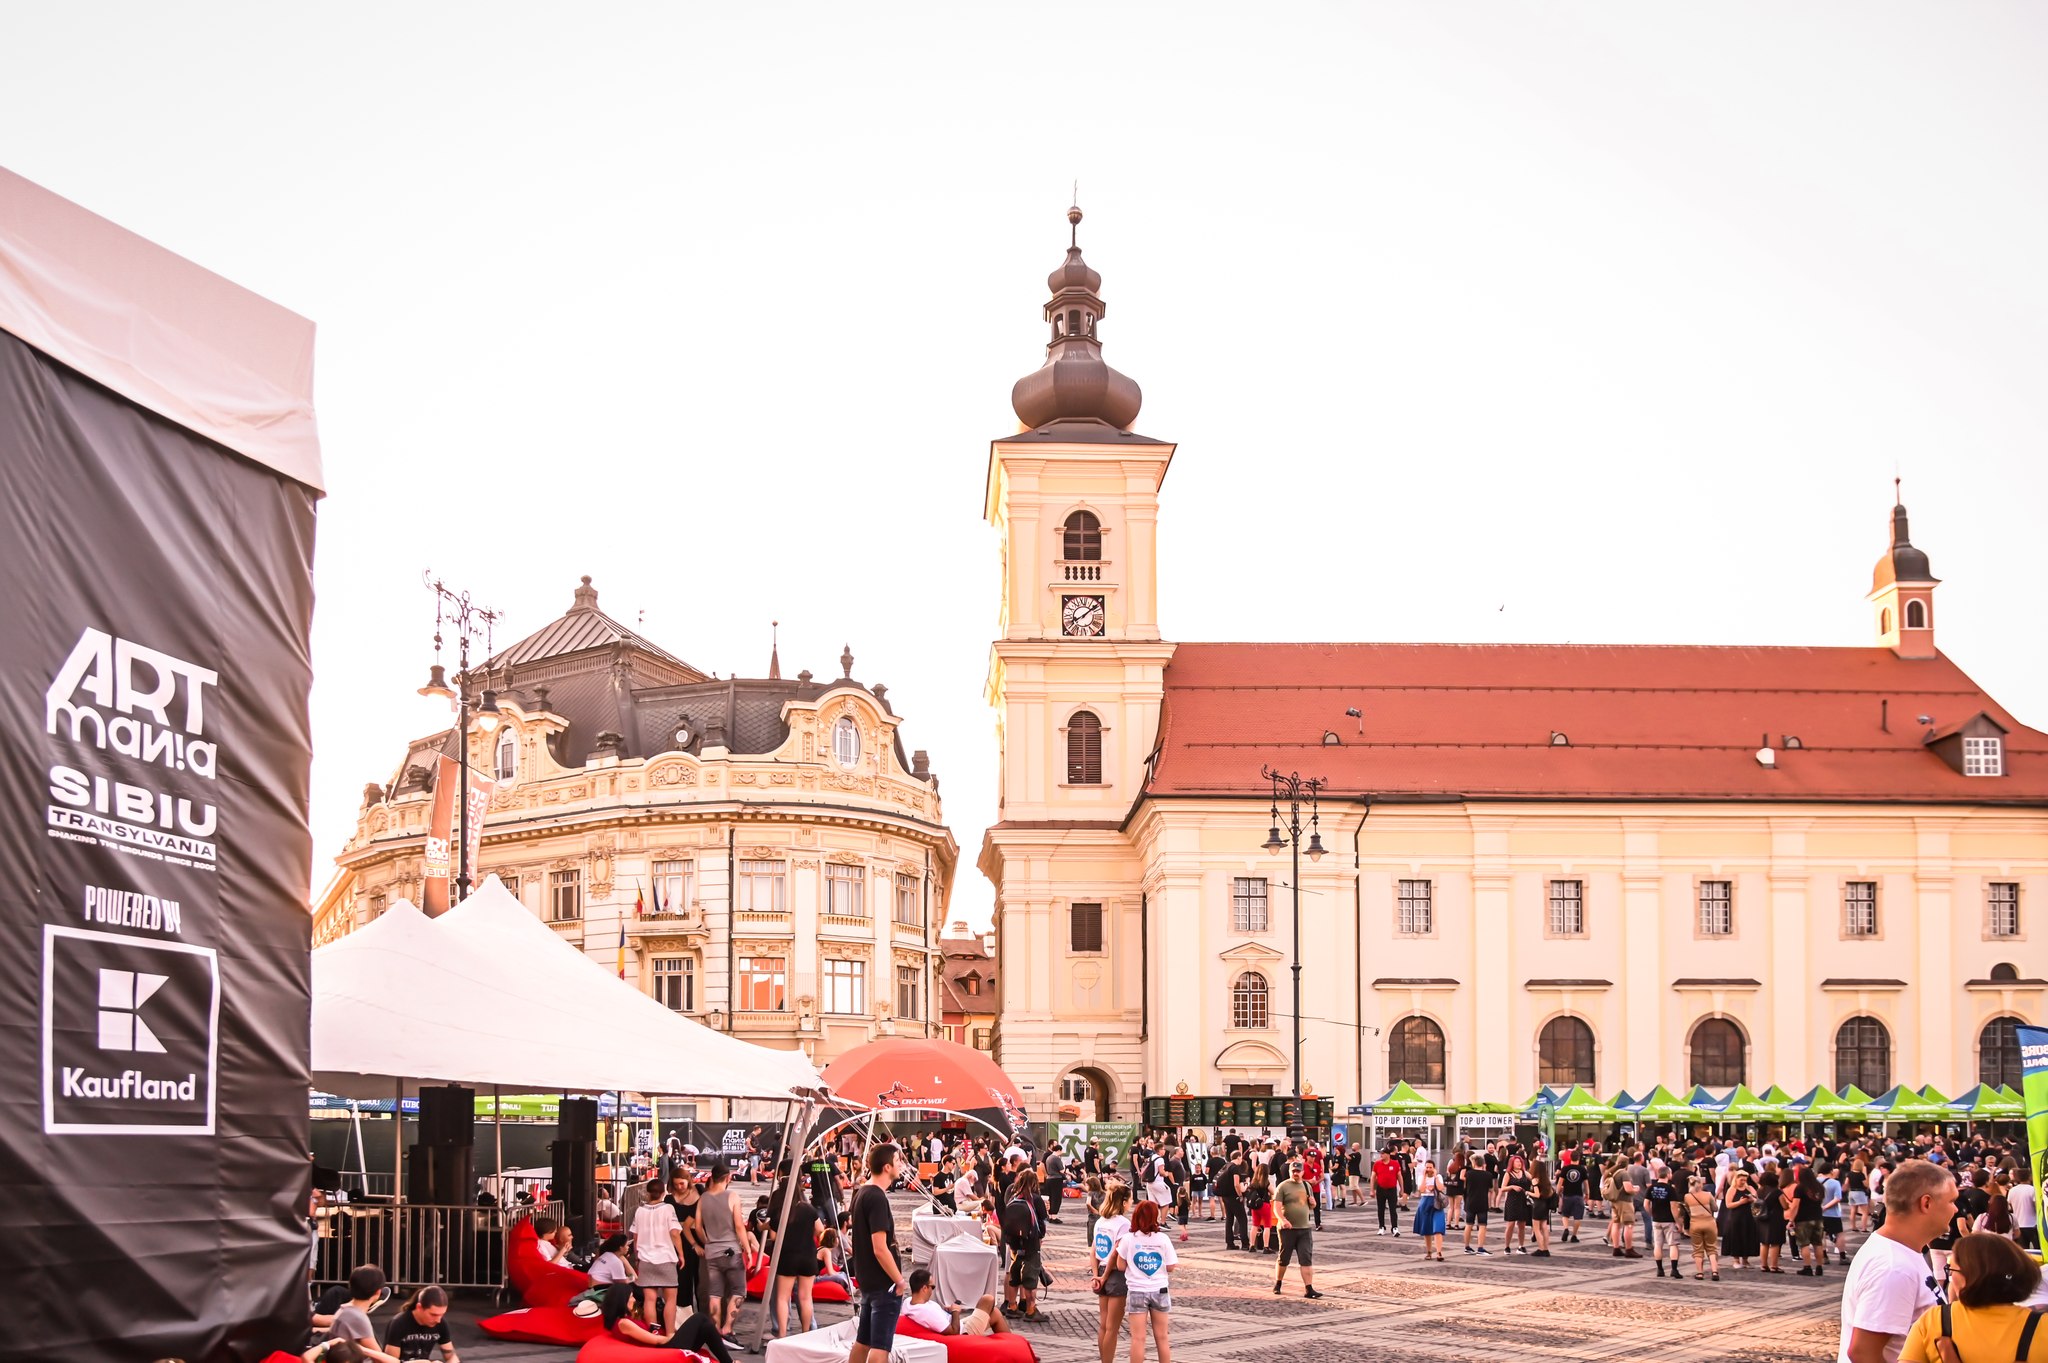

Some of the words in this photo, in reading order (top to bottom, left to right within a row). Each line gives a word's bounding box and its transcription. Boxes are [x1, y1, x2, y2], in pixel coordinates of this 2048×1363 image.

[46, 626, 218, 736] ART
[49, 765, 217, 838] SIBIU
[48, 829, 97, 845] SHAKING
[99, 839, 118, 850] THE
[119, 844, 164, 861] GROUNDS
[165, 855, 192, 867] SINCE
[52, 809, 213, 858] TRANSYLVANIA
[85, 885, 161, 931] POWERED
[162, 899, 181, 934] BY
[63, 1067, 196, 1101] Kaufland
[901, 1097, 947, 1105] CRAZYWOLF
[1403, 1116, 1427, 1125] TOWER
[1488, 1116, 1513, 1125] TOWER
[1104, 1146, 1119, 1165] 2
[1138, 1263, 1158, 1271] HOPE
